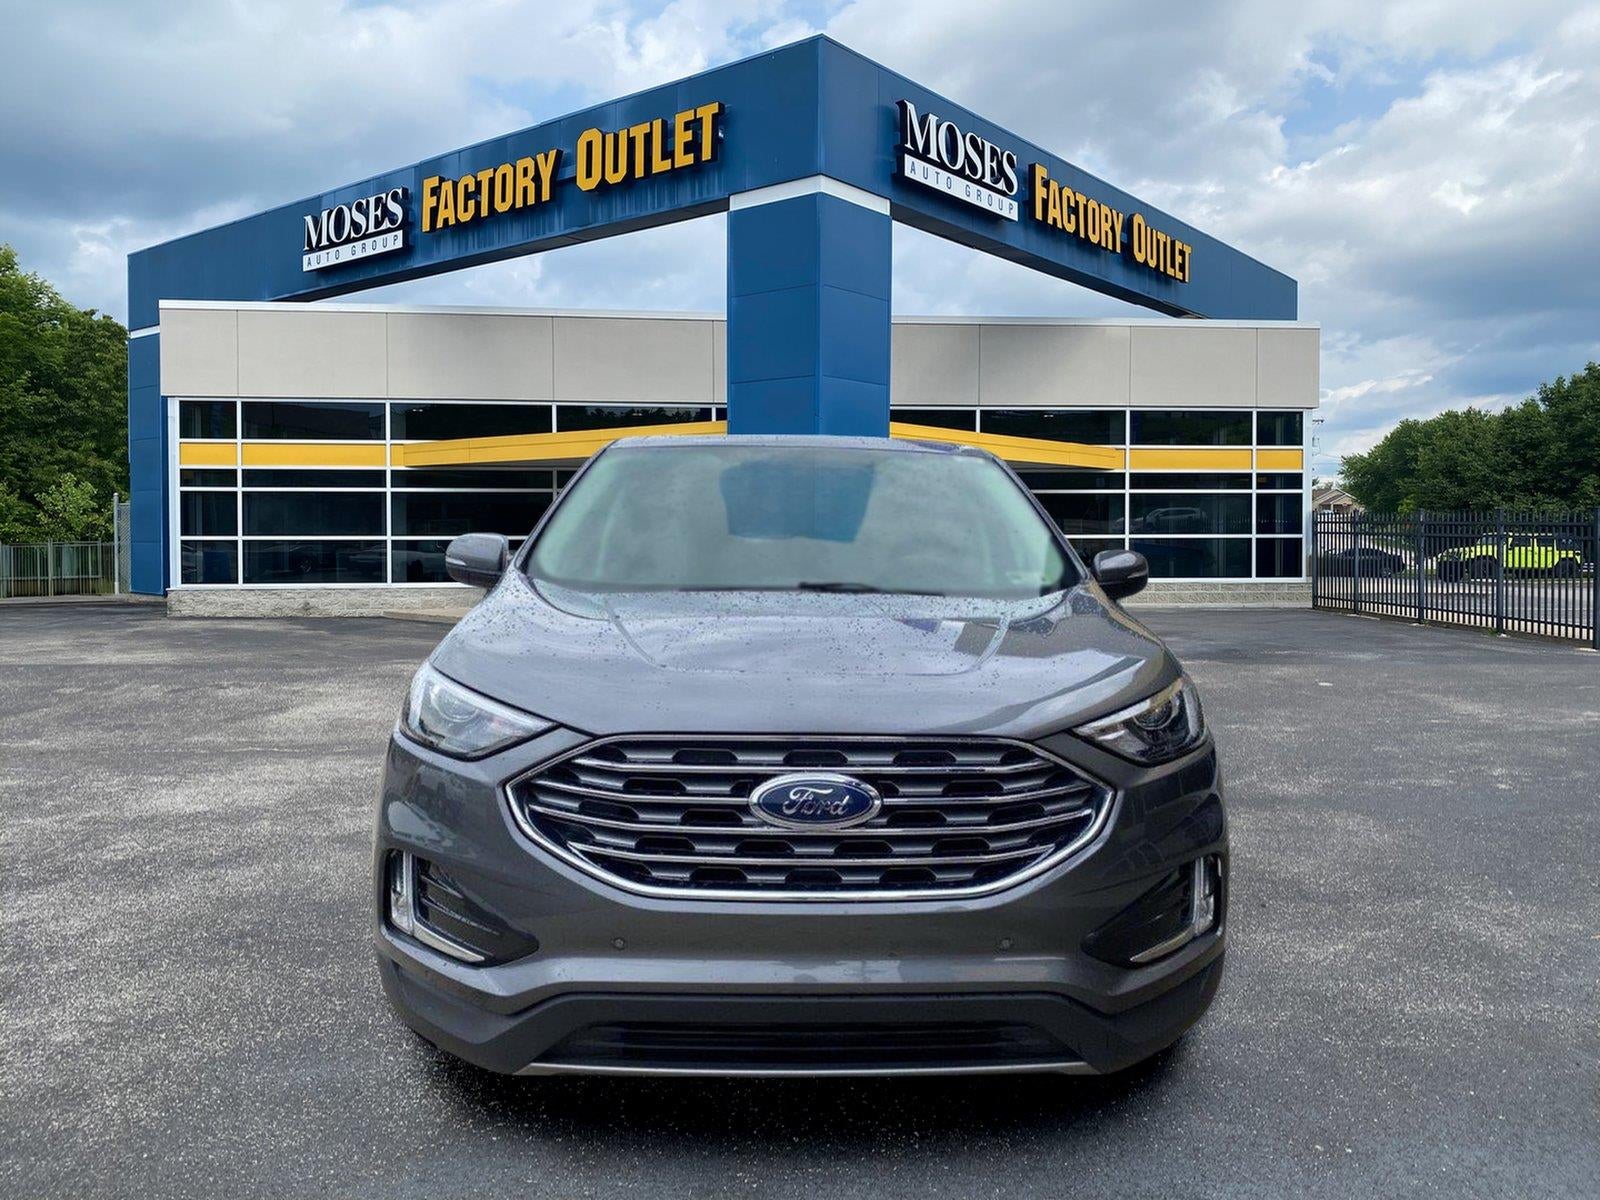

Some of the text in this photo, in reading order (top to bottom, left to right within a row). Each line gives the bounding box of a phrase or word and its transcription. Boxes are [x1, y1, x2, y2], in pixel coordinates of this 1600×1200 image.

[903, 99, 1019, 196] MOSES
[909, 160, 1015, 215] AUTO GROUP
[303, 188, 404, 251] MOSES
[307, 234, 399, 268] AUTO GROUP
[782, 787, 850, 816] Ford
